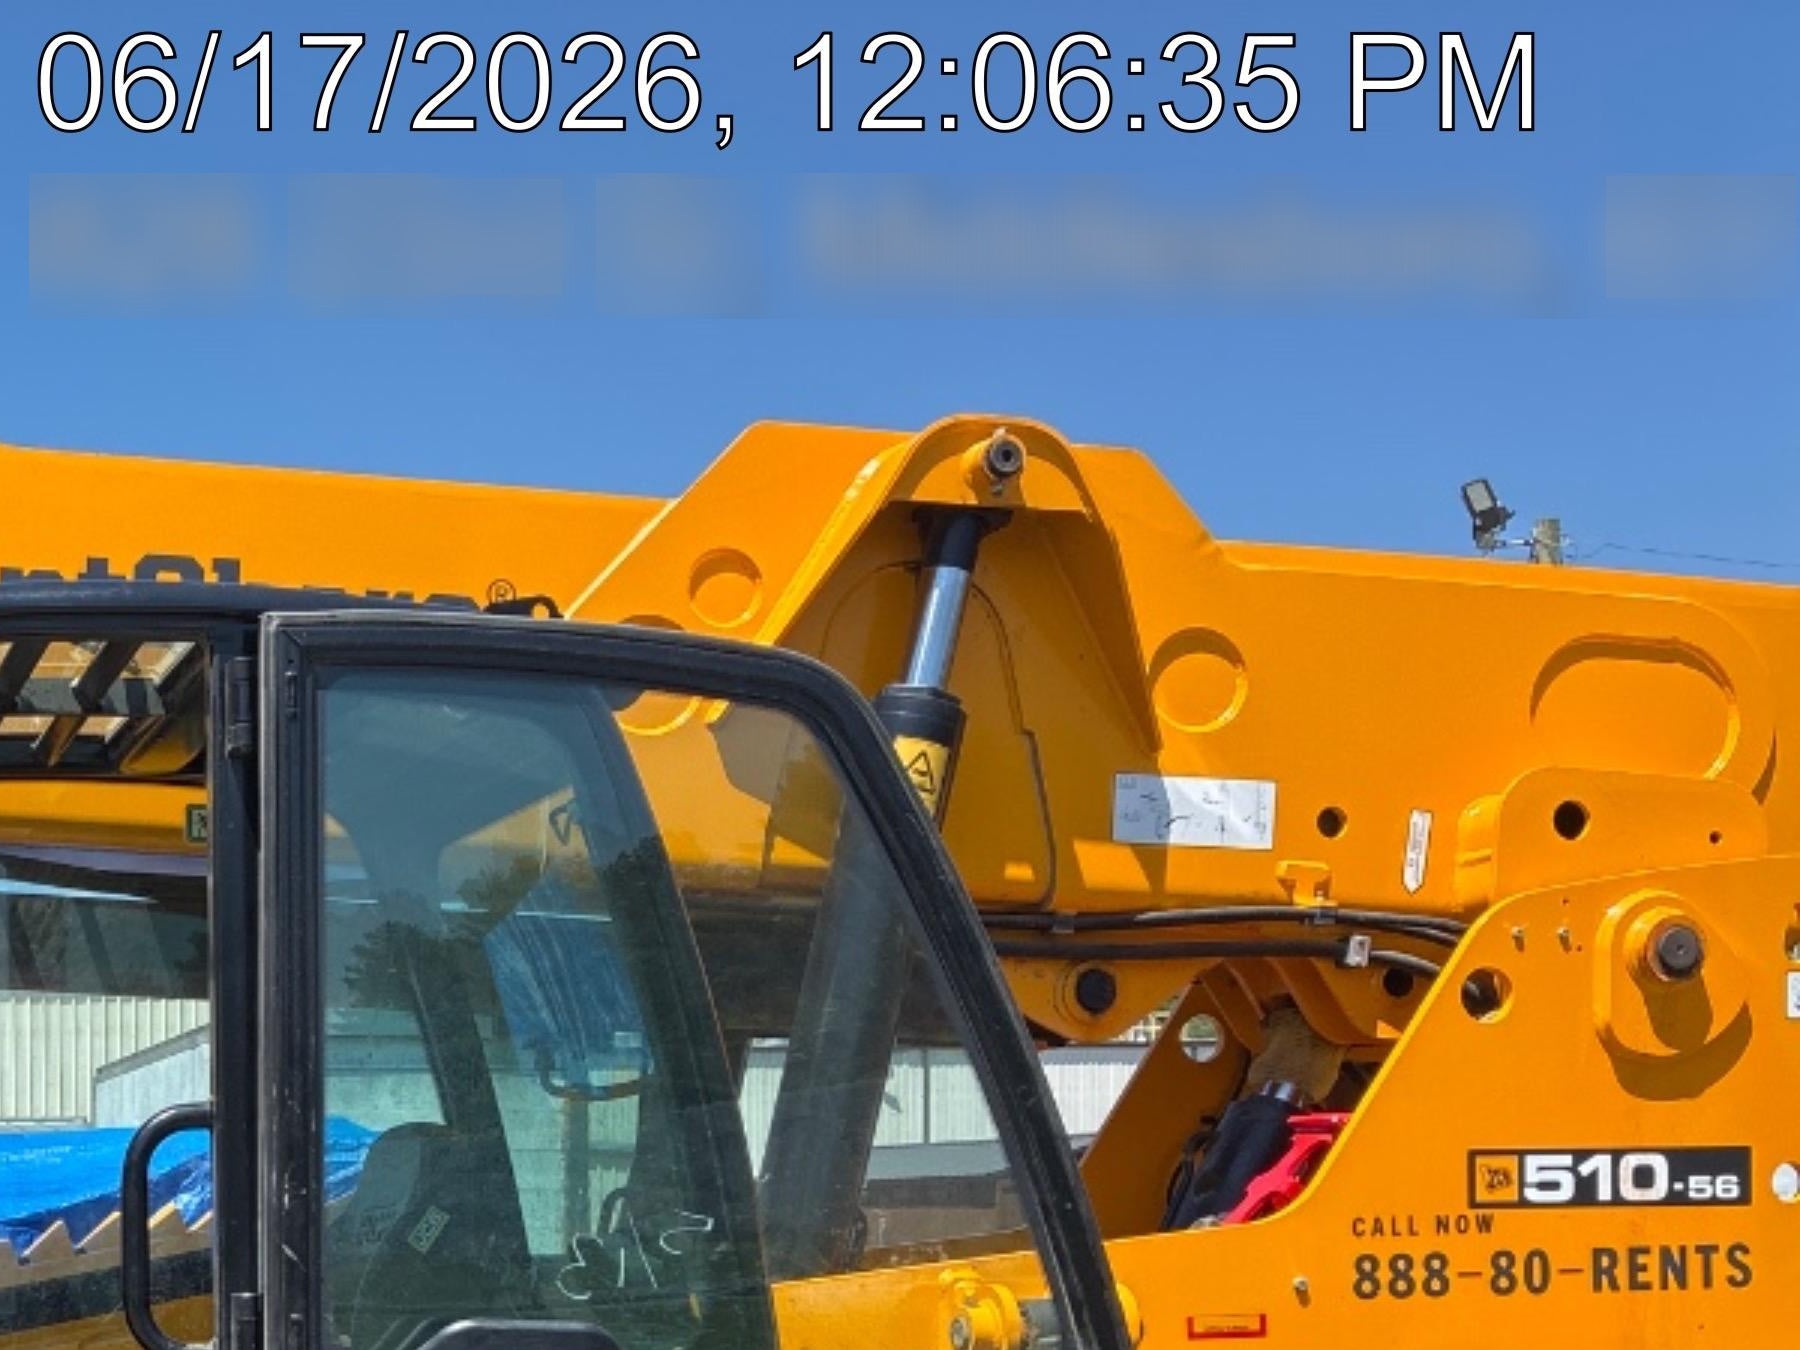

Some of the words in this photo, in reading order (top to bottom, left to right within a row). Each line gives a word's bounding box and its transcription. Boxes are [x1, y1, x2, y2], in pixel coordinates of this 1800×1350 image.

[1522, 1151, 1741, 1204] 510-56
[1351, 1215, 1420, 1238] CALL
[1435, 1212, 1496, 1235] NOW
[1351, 1241, 1754, 1301] 888-80-RENTS
